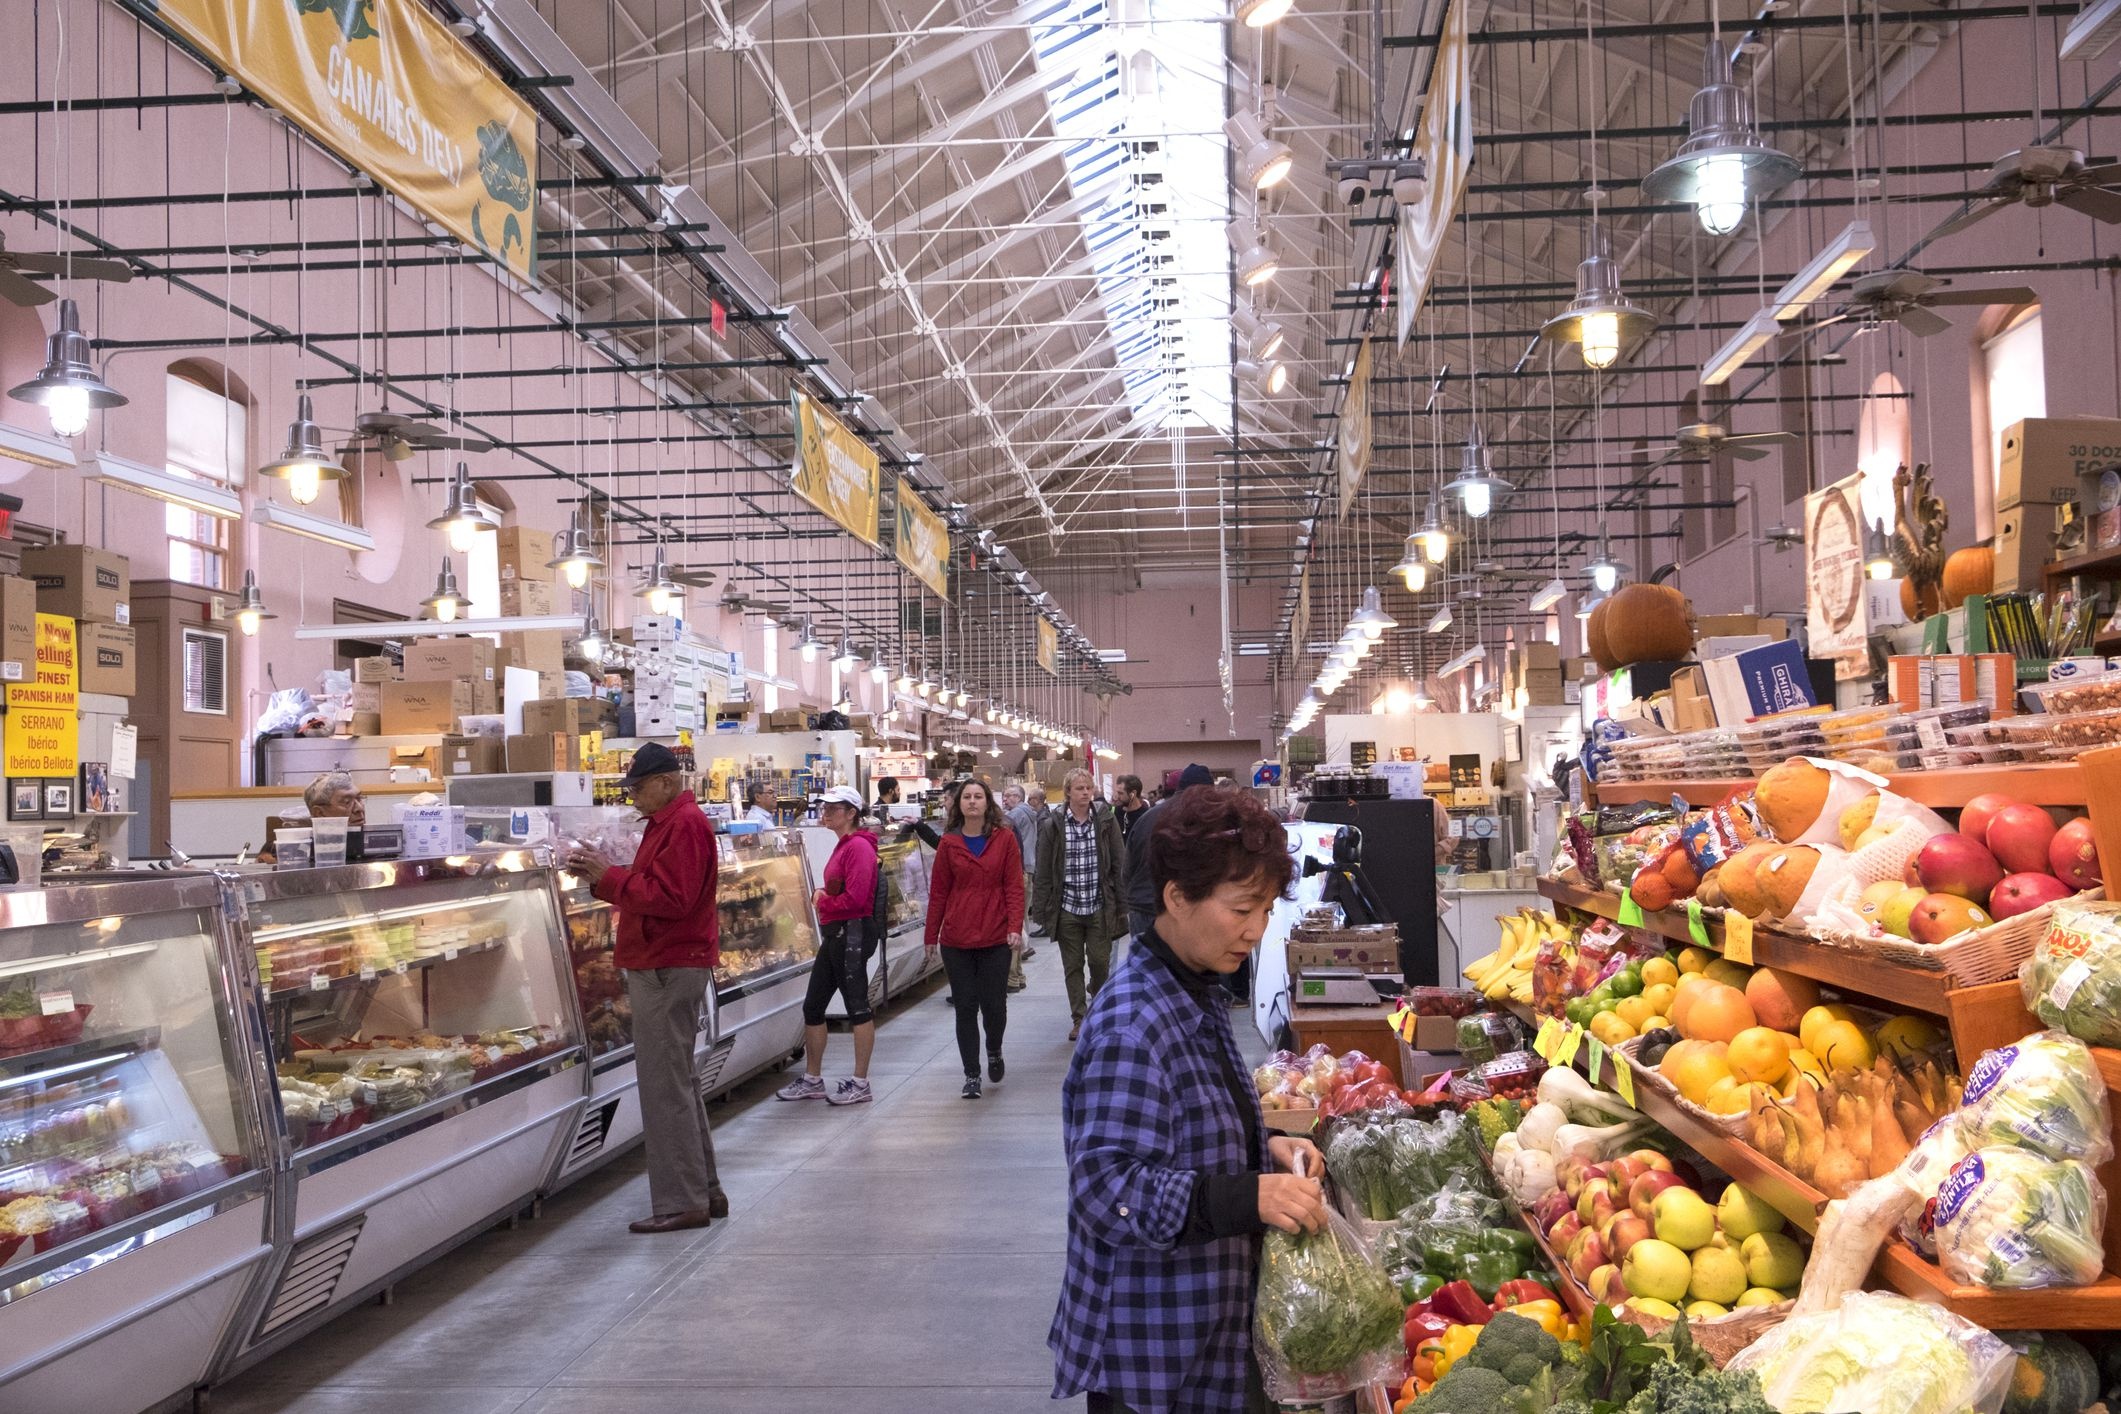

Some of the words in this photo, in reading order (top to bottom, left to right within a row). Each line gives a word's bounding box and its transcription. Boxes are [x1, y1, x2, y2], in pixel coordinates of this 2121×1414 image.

[327, 44, 417, 156] CANALES
[420, 118, 463, 189] DELI
[2069, 445, 2086, 457] 30
[98, 573, 117, 585] SOLO
[9, 623, 28, 633] WNA
[36, 645, 73, 668] elling
[99, 654, 121, 663] SOLO
[37, 671, 70, 685] FINEST
[1776, 668, 1794, 708] GHIRA
[11, 688, 52, 703] SPANISH
[55, 691, 75, 704] HAM
[21, 714, 65, 731] SERRANO
[28, 735, 58, 750] Ibérico
[10, 755, 41, 770] Ibérico
[43, 755, 74, 770] Bellota
